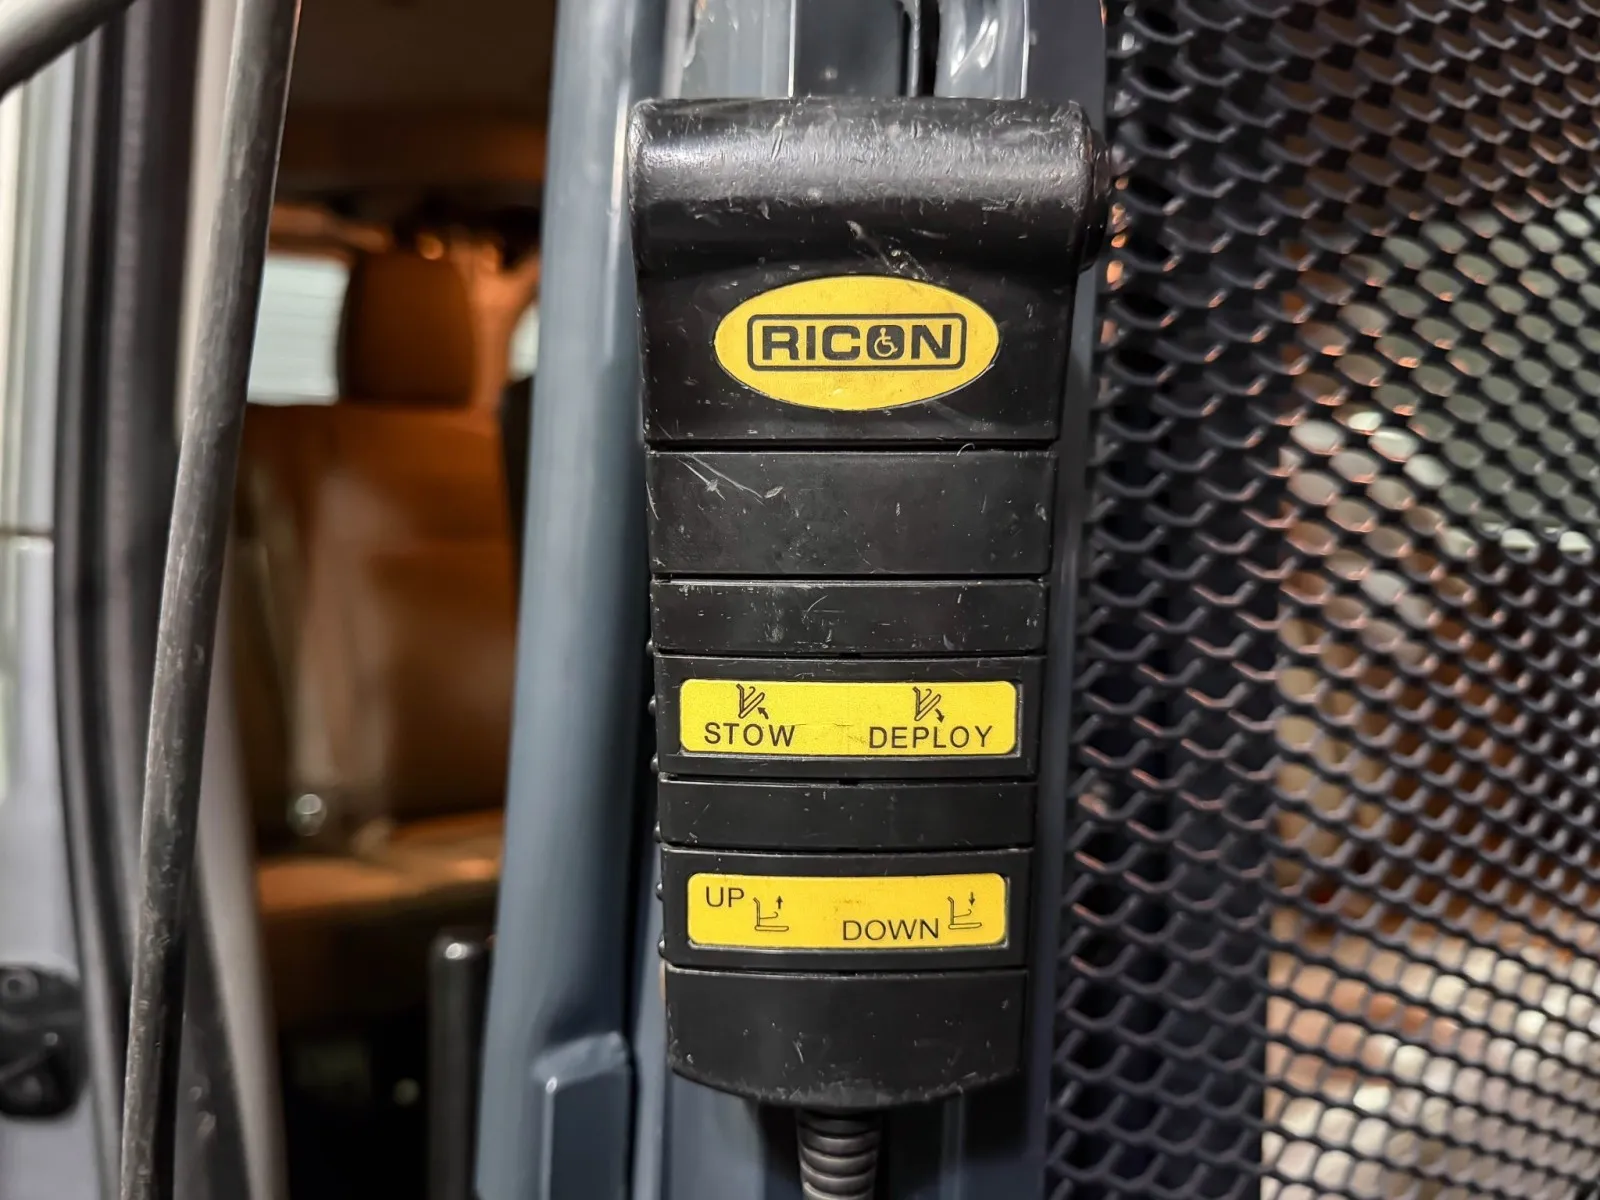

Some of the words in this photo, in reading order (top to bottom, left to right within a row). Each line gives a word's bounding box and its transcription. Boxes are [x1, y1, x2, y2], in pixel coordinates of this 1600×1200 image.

[762, 324, 952, 361] RICON
[703, 722, 796, 747] STOW
[869, 725, 993, 749] DEPLOY
[705, 886, 745, 908] UP
[842, 918, 939, 941] DOWN
